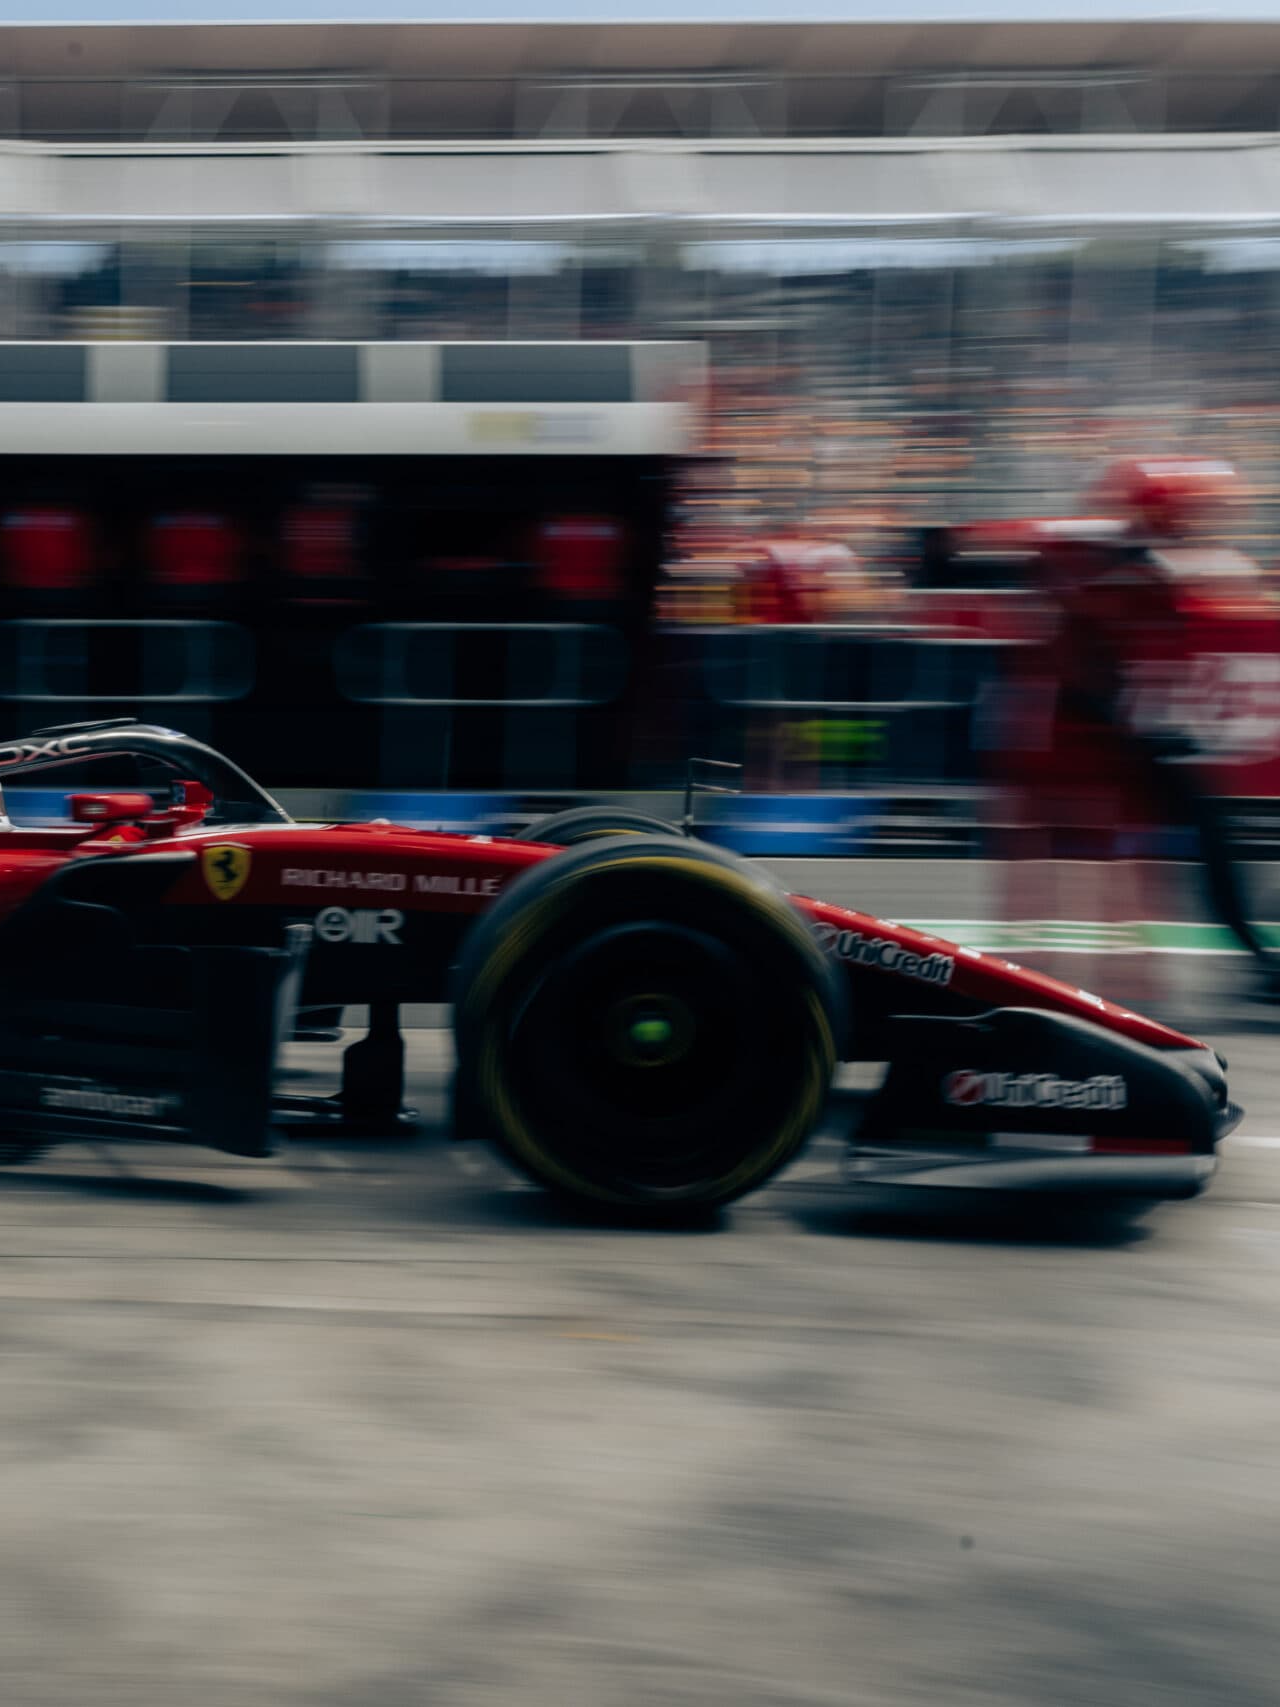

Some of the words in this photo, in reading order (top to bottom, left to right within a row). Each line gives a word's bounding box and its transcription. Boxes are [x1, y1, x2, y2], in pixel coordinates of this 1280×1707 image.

[282, 868, 407, 890] RICHARD
[415, 875, 501, 895] MILLE
[837, 930, 955, 985] UniCredit
[984, 1073, 1126, 1109] UniCredit
